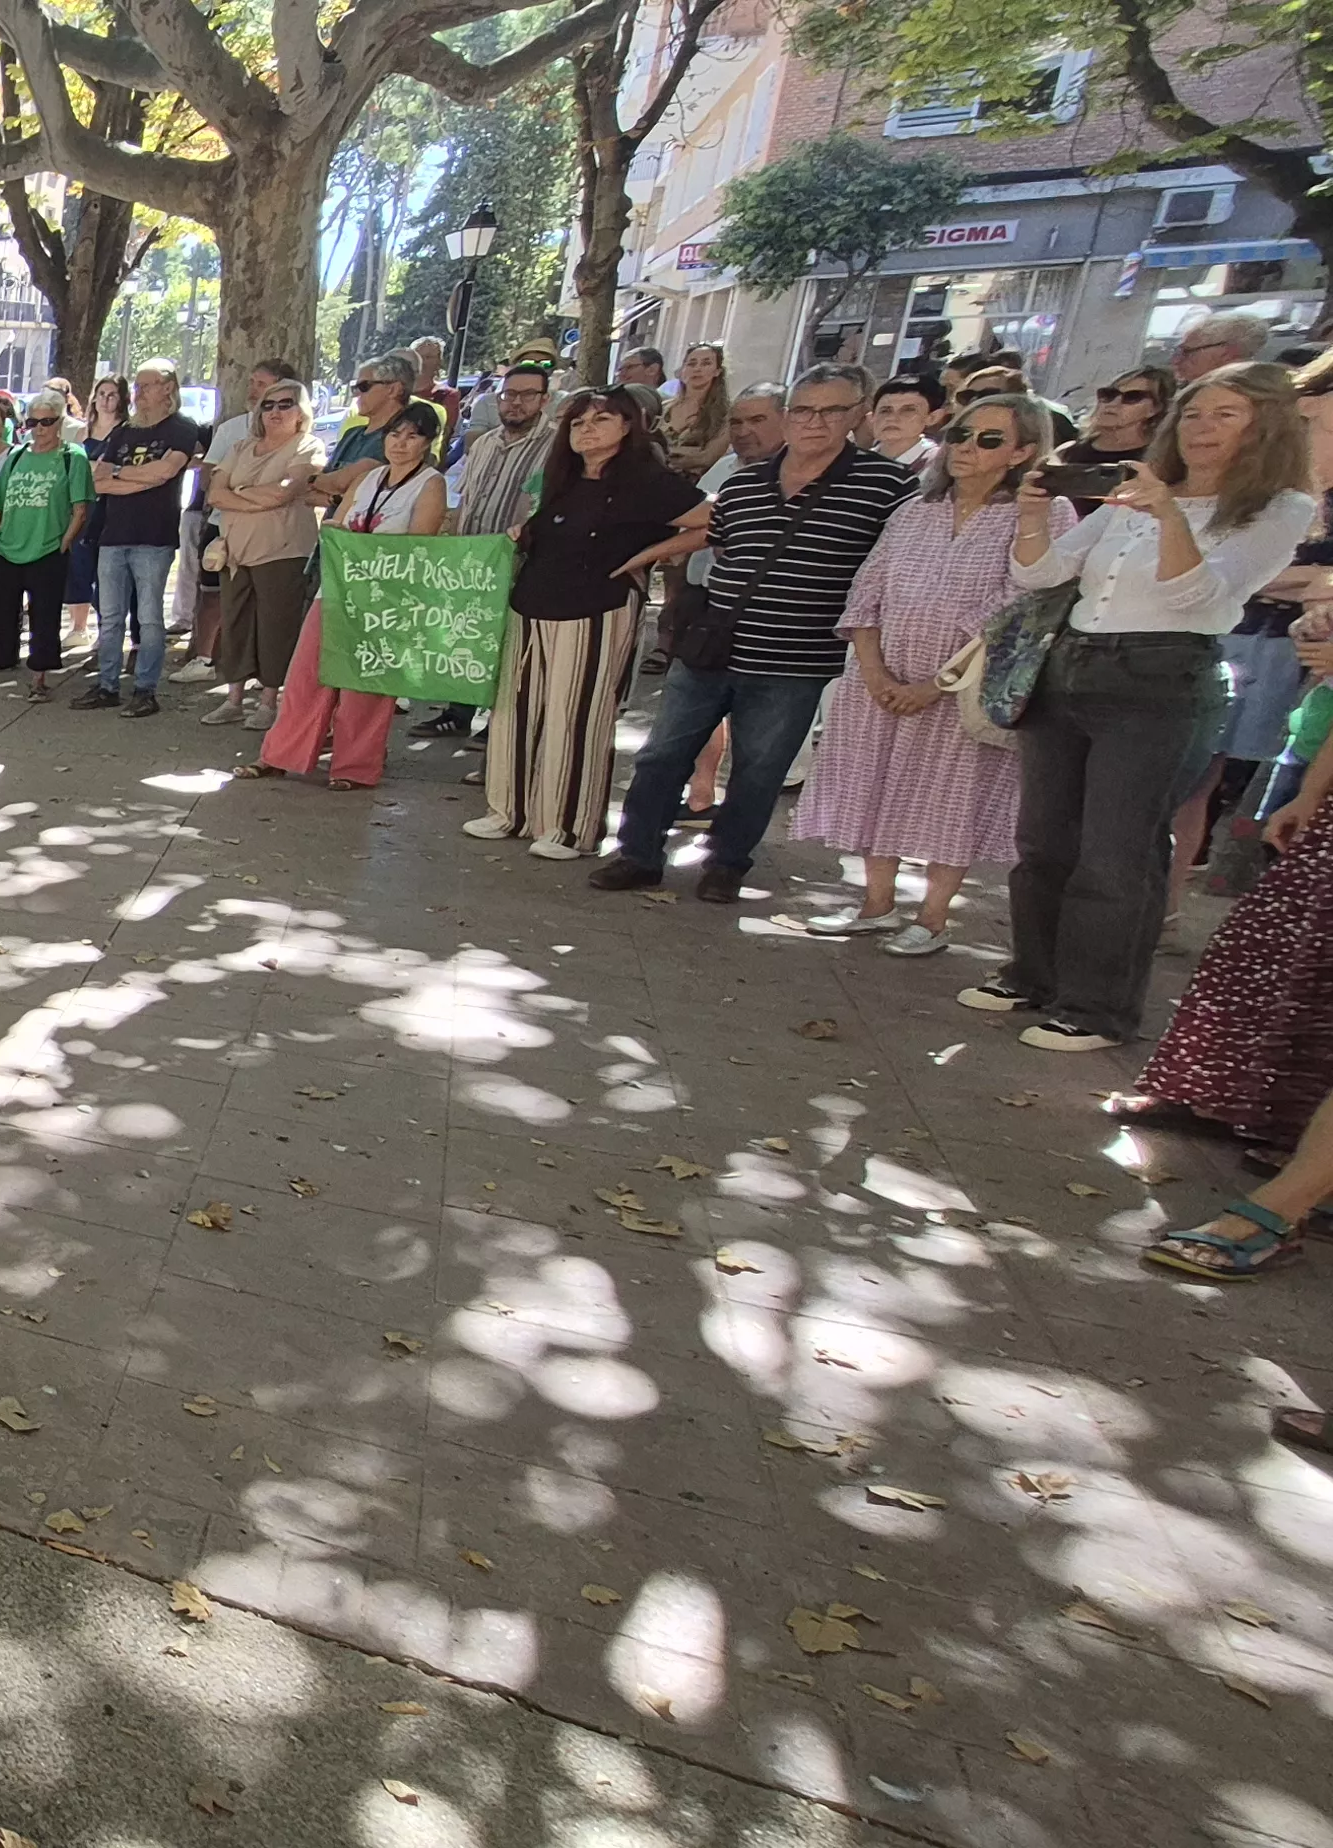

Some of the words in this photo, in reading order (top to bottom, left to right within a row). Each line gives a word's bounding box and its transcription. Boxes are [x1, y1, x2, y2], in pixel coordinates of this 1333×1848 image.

[922, 224, 1007, 244] SIGMA
[364, 608, 398, 632] DE
[361, 648, 414, 671] PARA
